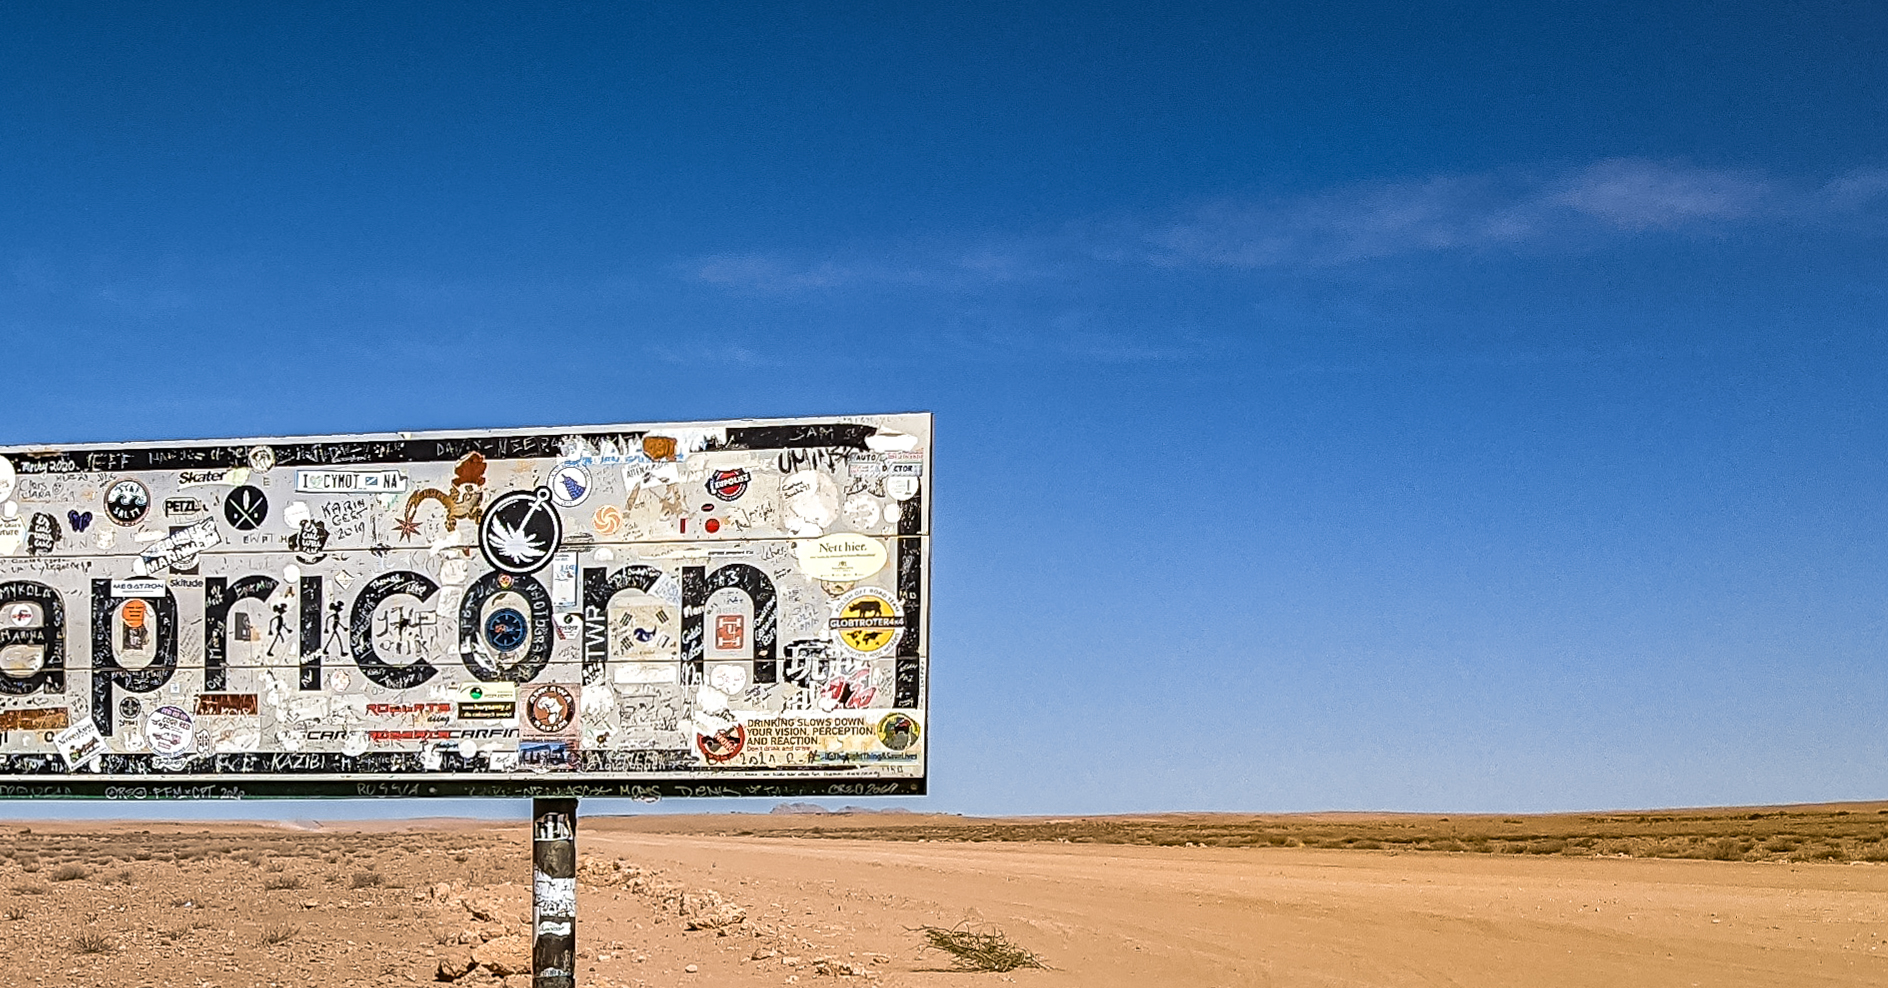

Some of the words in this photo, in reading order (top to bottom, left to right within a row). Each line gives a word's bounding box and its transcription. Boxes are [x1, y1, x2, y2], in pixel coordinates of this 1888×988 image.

[179, 471, 227, 485] Skater
[165, 501, 200, 516] PETZL
[819, 542, 842, 552] Nett
[845, 541, 867, 552] hier.
[170, 578, 204, 588] Skitude
[747, 719, 795, 728] DRINKING
[797, 718, 832, 727] SLOWS
[835, 718, 865, 726] DOWN
[747, 728, 772, 736] YOUR
[747, 737, 768, 746] AND
[770, 736, 821, 746] REACTION.
